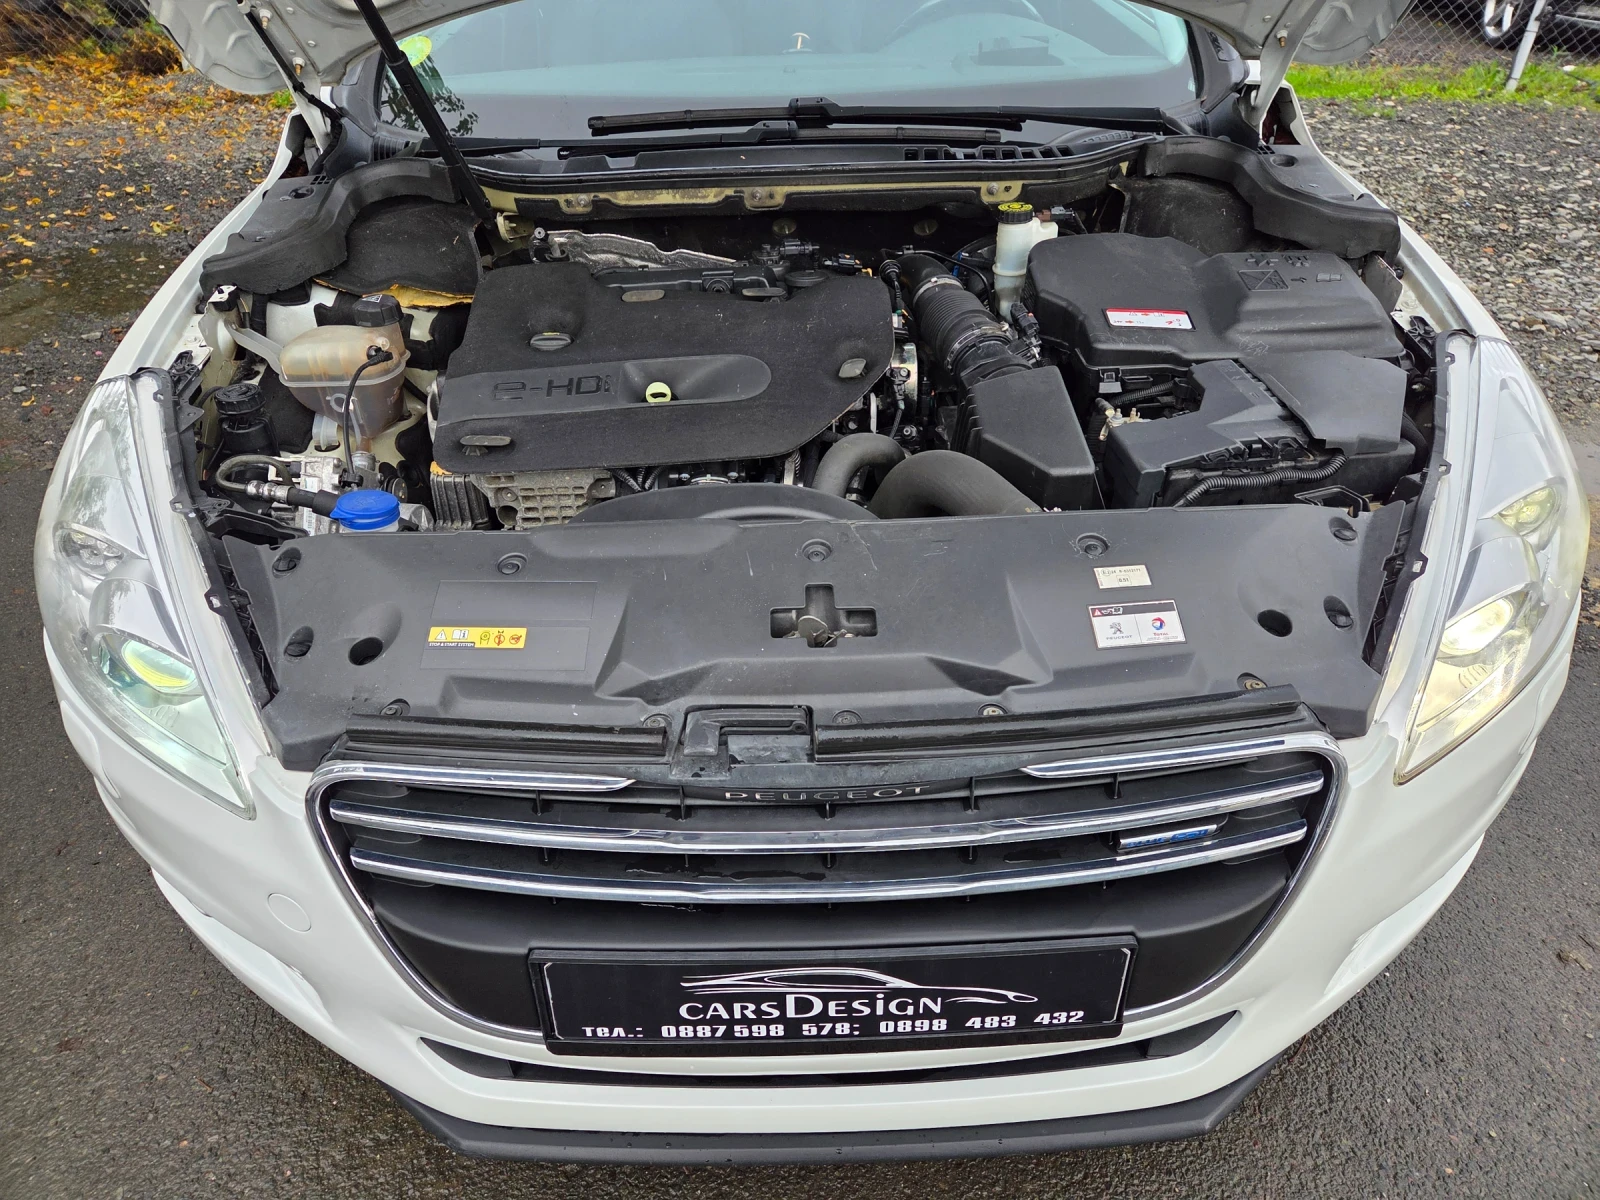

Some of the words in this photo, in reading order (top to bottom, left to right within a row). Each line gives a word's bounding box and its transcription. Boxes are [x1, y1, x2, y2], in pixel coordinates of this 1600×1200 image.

[493, 374, 611, 400] e-HDi
[725, 785, 930, 801] PEUGEOT
[661, 1025, 727, 1038] 0887
[733, 1024, 785, 1037] 598
[879, 1018, 948, 1034] 0898
[964, 1015, 1017, 1029] 483
[1033, 1010, 1085, 1025] 432
